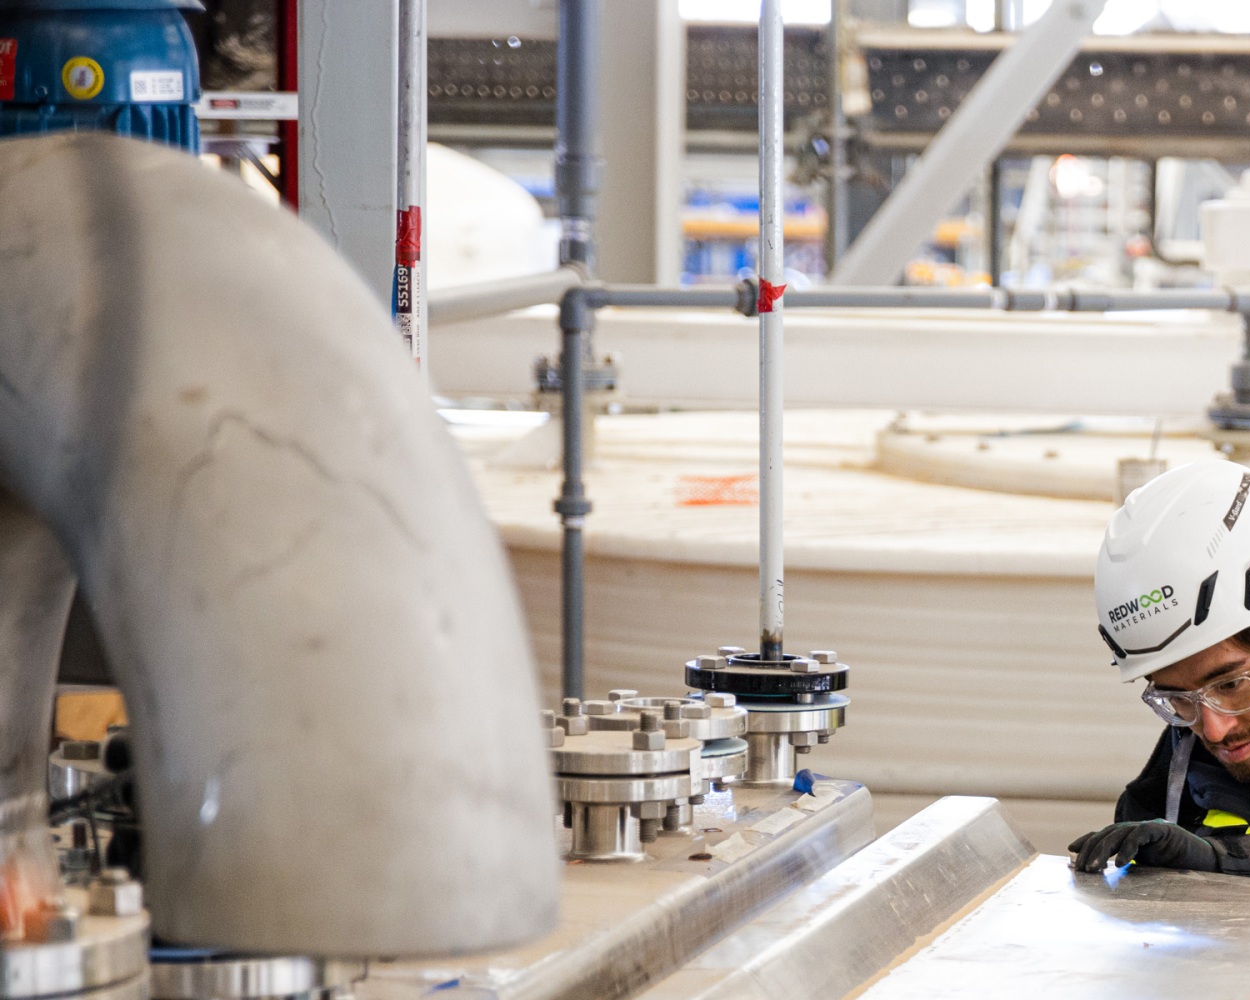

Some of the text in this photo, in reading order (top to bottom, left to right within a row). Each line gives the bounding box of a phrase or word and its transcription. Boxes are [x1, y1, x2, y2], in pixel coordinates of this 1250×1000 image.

[1228, 499, 1242, 521] V-Gard
[1108, 585, 1174, 624] REDWOOD
[1113, 598, 1178, 633] MATERIALS
